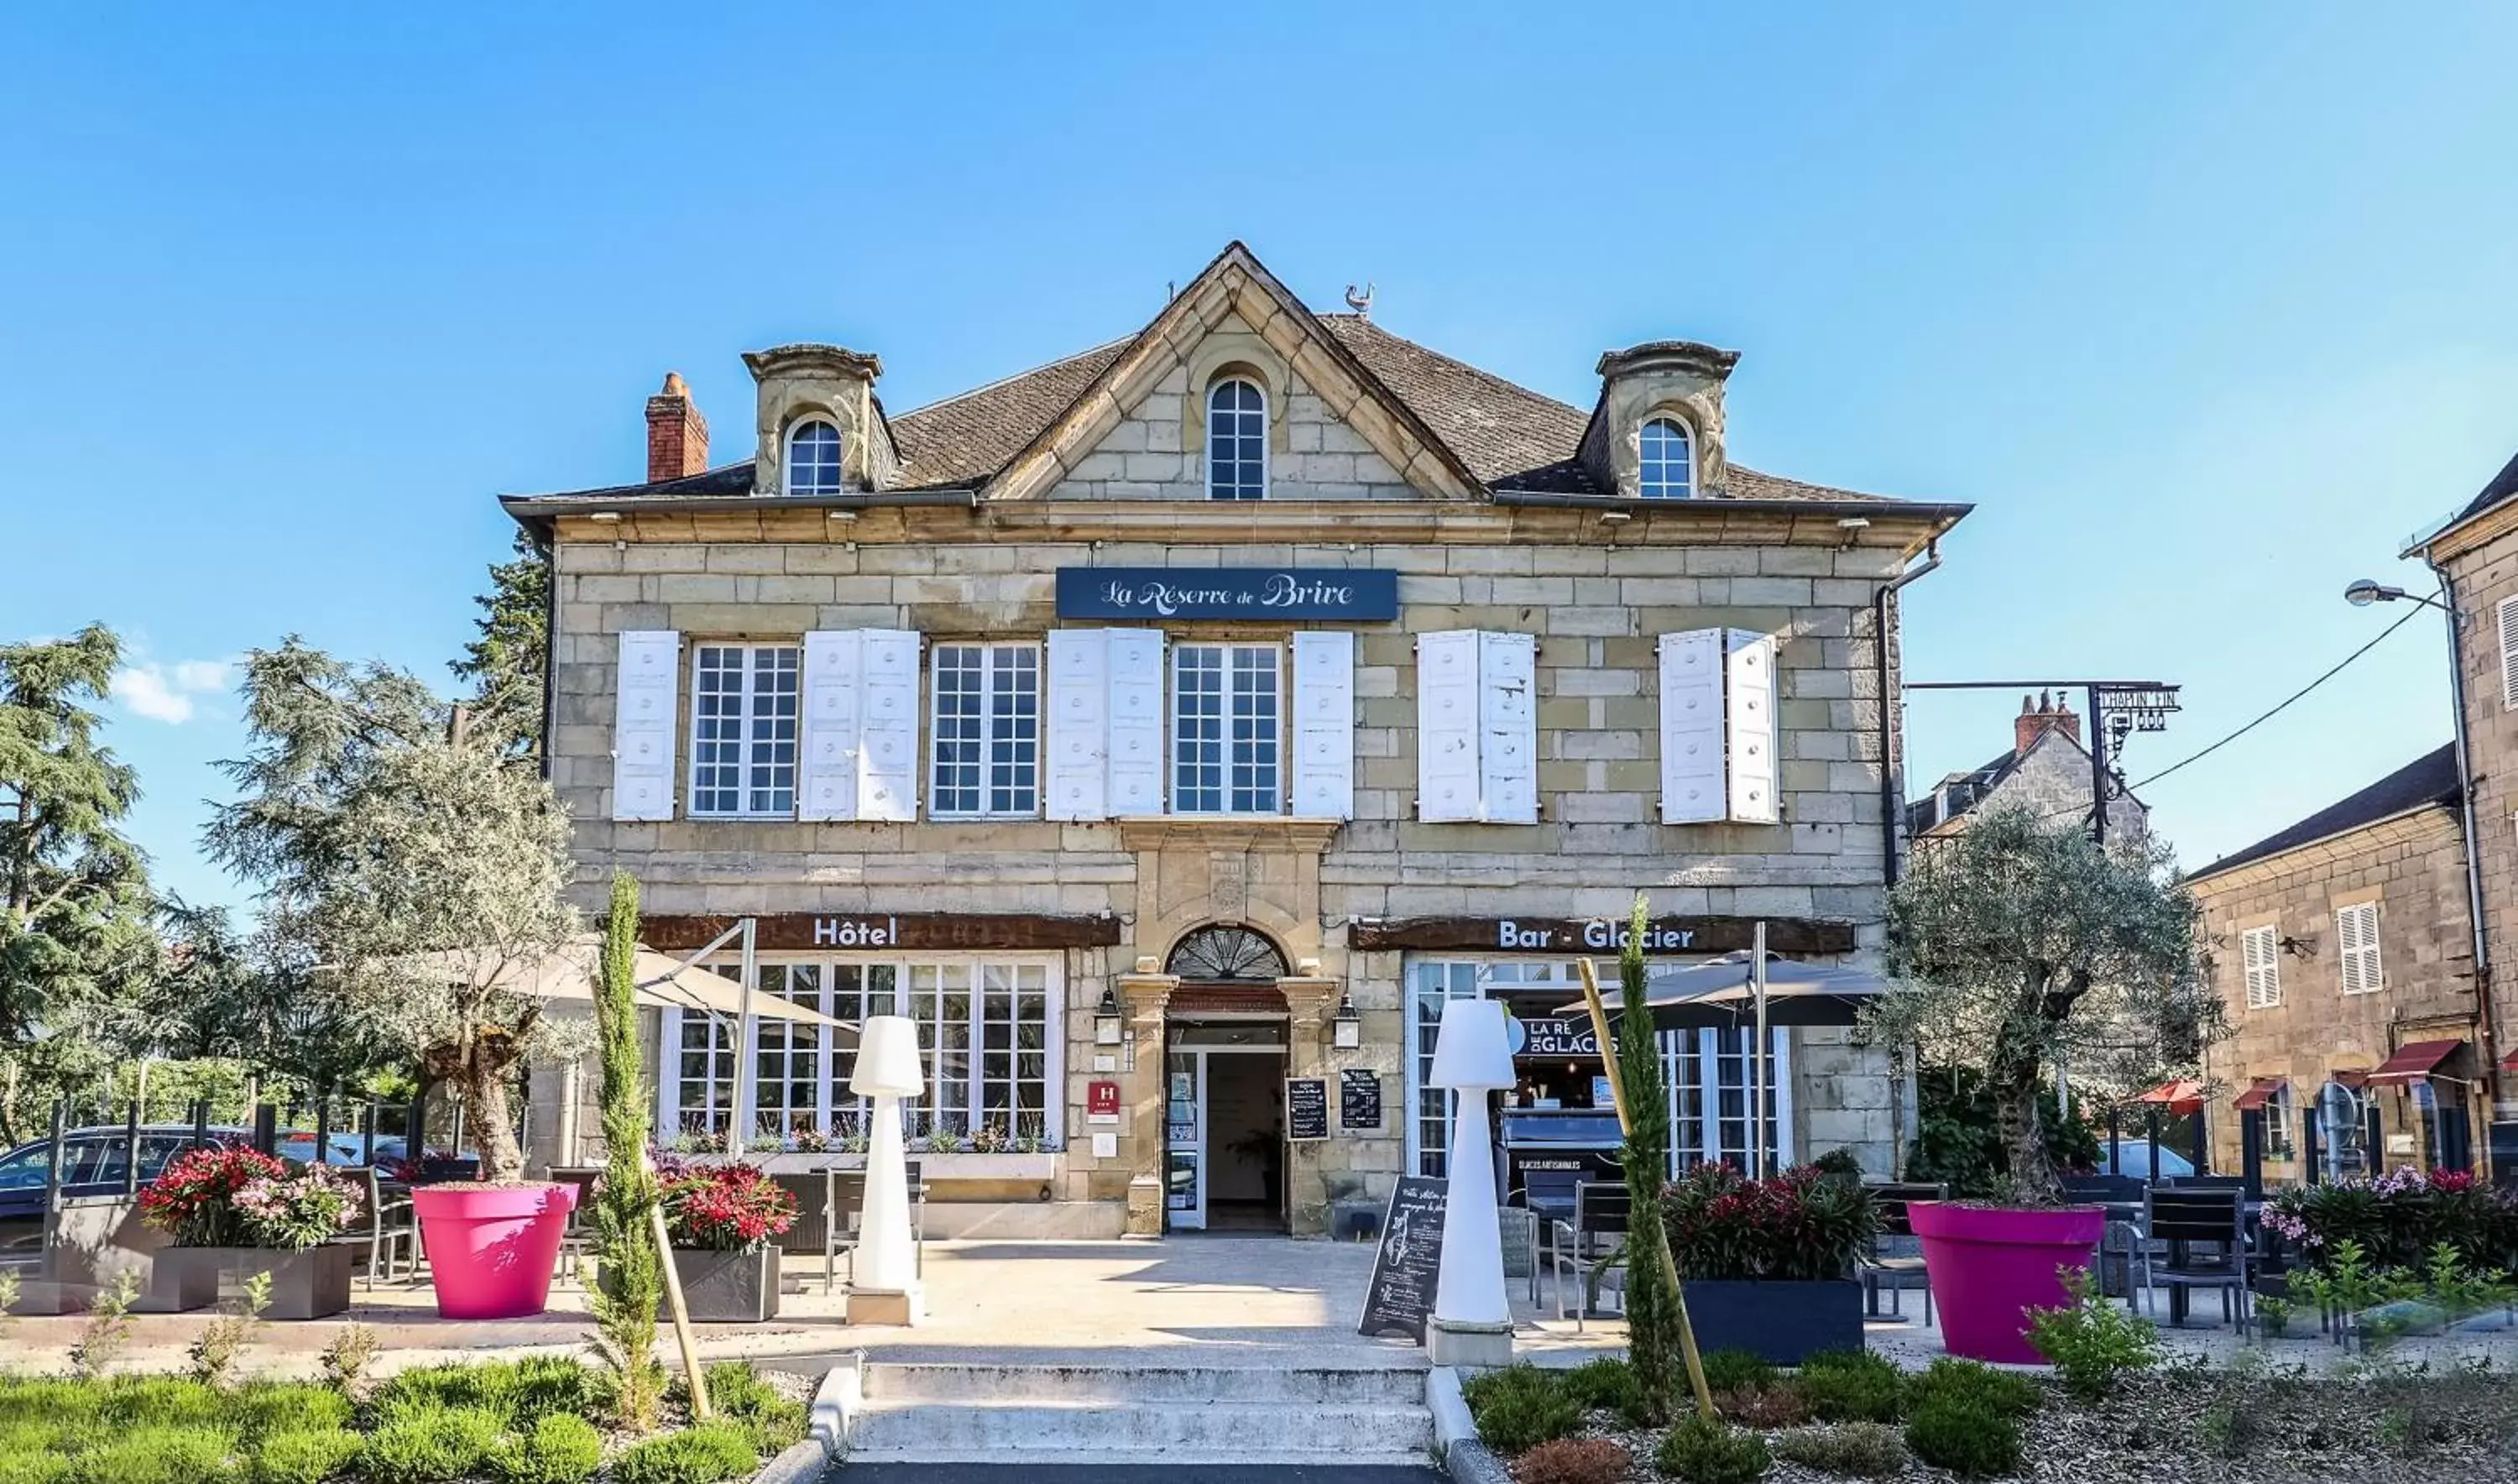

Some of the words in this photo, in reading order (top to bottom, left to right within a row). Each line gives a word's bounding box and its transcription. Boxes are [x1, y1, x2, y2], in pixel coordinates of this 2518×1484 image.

[1100, 579, 1131, 607] La
[1138, 583, 1231, 615] Réserve
[1236, 590, 1254, 604] de
[1261, 573, 1353, 607] Brive
[814, 917, 897, 945] Hôtel
[1500, 921, 1552, 948] Bar
[1530, 1023, 1549, 1034] LA
[1531, 1037, 1541, 1052] DE
[1100, 1088, 1114, 1100] H
